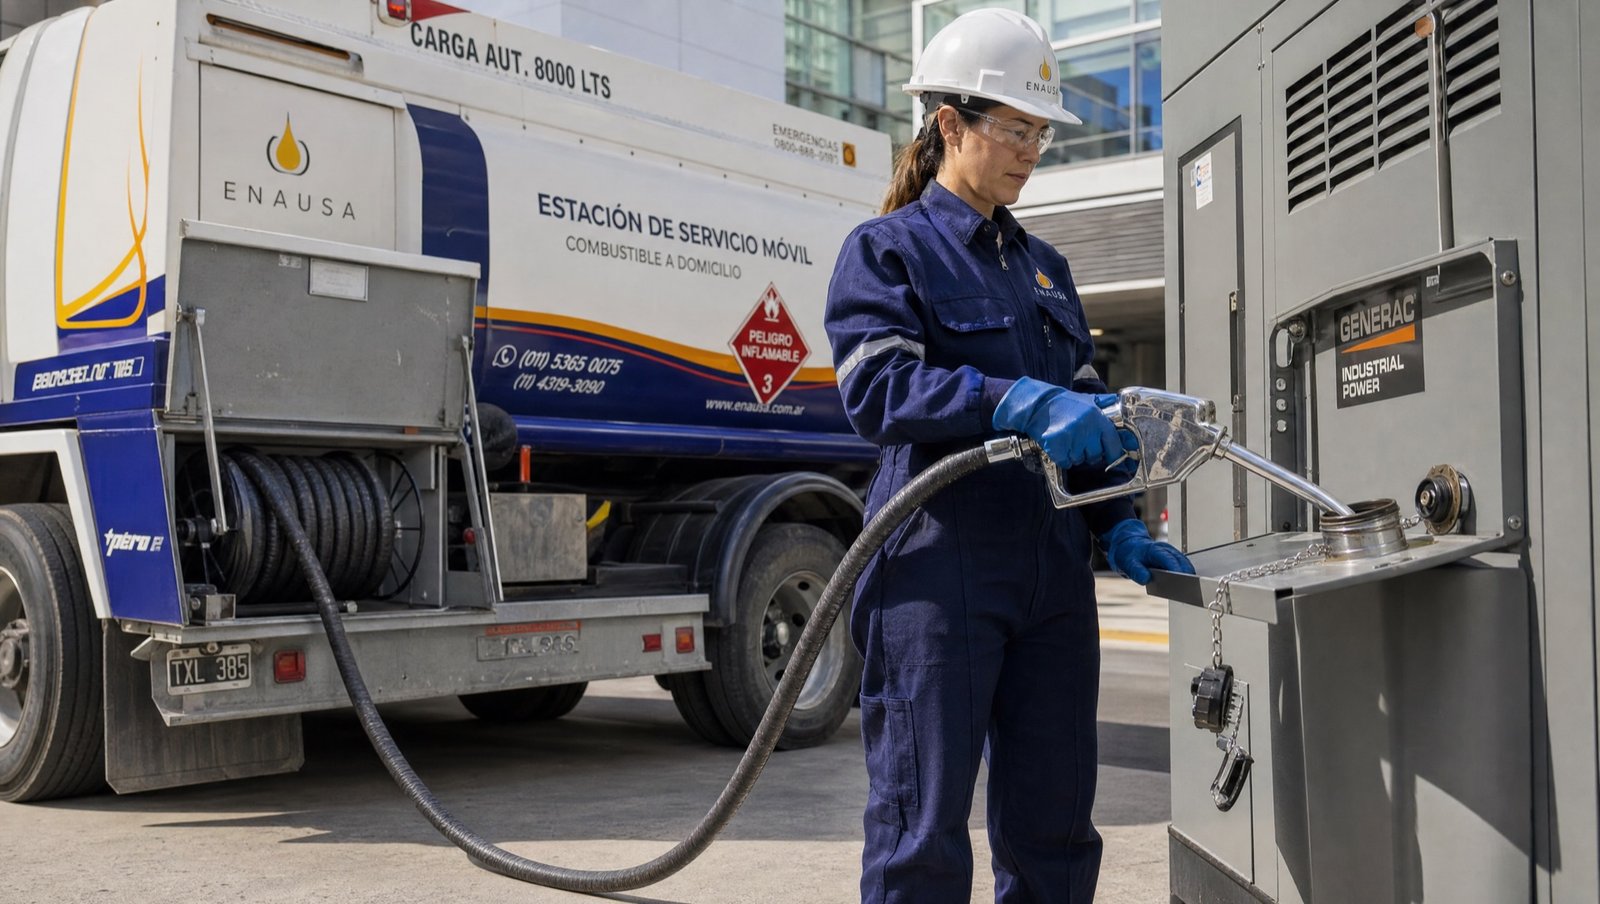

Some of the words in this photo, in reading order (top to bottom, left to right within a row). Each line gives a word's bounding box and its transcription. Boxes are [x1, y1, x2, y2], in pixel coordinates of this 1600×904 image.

[411, 22, 479, 63] CARGA
[485, 43, 528, 77] AUT.
[535, 56, 575, 89] 8000
[581, 69, 611, 99] LTS
[772, 123, 839, 153] EMERGENCIAS
[224, 181, 356, 220] ENAUSA
[537, 192, 643, 234] ESTACIÓN
[648, 215, 674, 239] DE
[679, 221, 759, 255] SERVICIO
[762, 237, 813, 266] MÓVIL
[565, 235, 662, 266] COMBUSTIBLE
[665, 256, 675, 269] A
[677, 257, 742, 280] DOMICILIO
[1340, 294, 1416, 343] GENERAC
[749, 329, 793, 347] PELIGRO
[518, 349, 551, 372] (011)
[550, 353, 588, 373] 5365
[587, 356, 624, 376] 0075
[741, 344, 800, 363] INFLAMABLE
[1341, 354, 1405, 383] INDUSTRIAL
[513, 372, 537, 391] (11)
[536, 375, 606, 395] 4319-3090
[761, 373, 774, 394] 3
[1342, 376, 1381, 400] POWER
[705, 399, 805, 416] www.enausa.com.ar
[171, 659, 206, 685] TXL
[215, 654, 248, 681] 385
